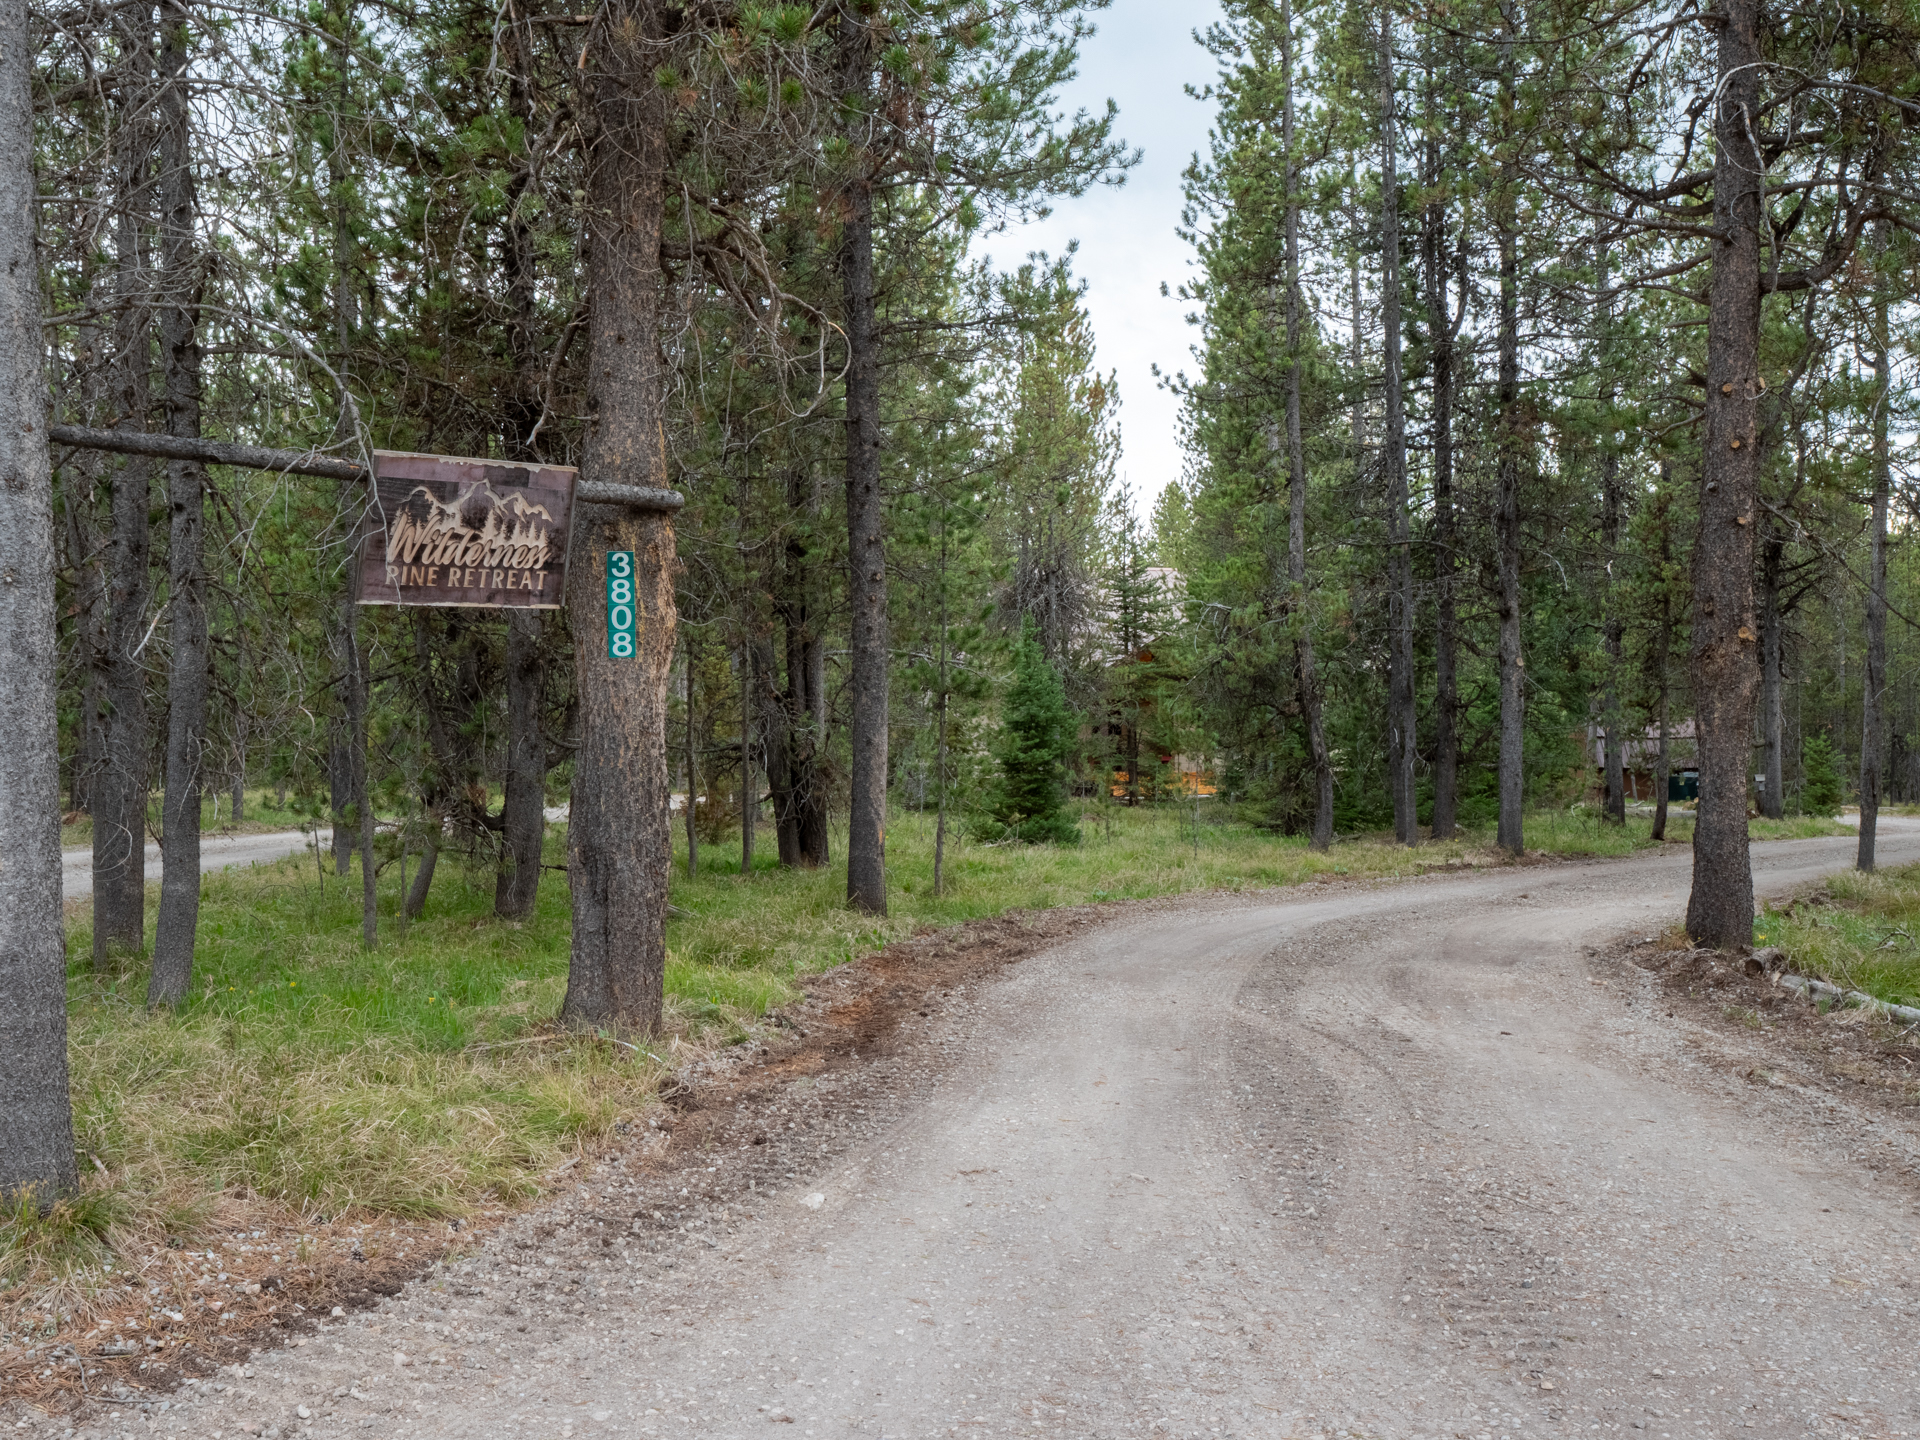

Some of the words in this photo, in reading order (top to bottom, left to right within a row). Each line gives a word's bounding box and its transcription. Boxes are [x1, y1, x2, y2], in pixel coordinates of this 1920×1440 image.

[388, 514, 551, 569] Wilderness
[386, 565, 439, 587] PINE
[448, 566, 548, 590] RETREAT
[611, 553, 633, 657] 3808
